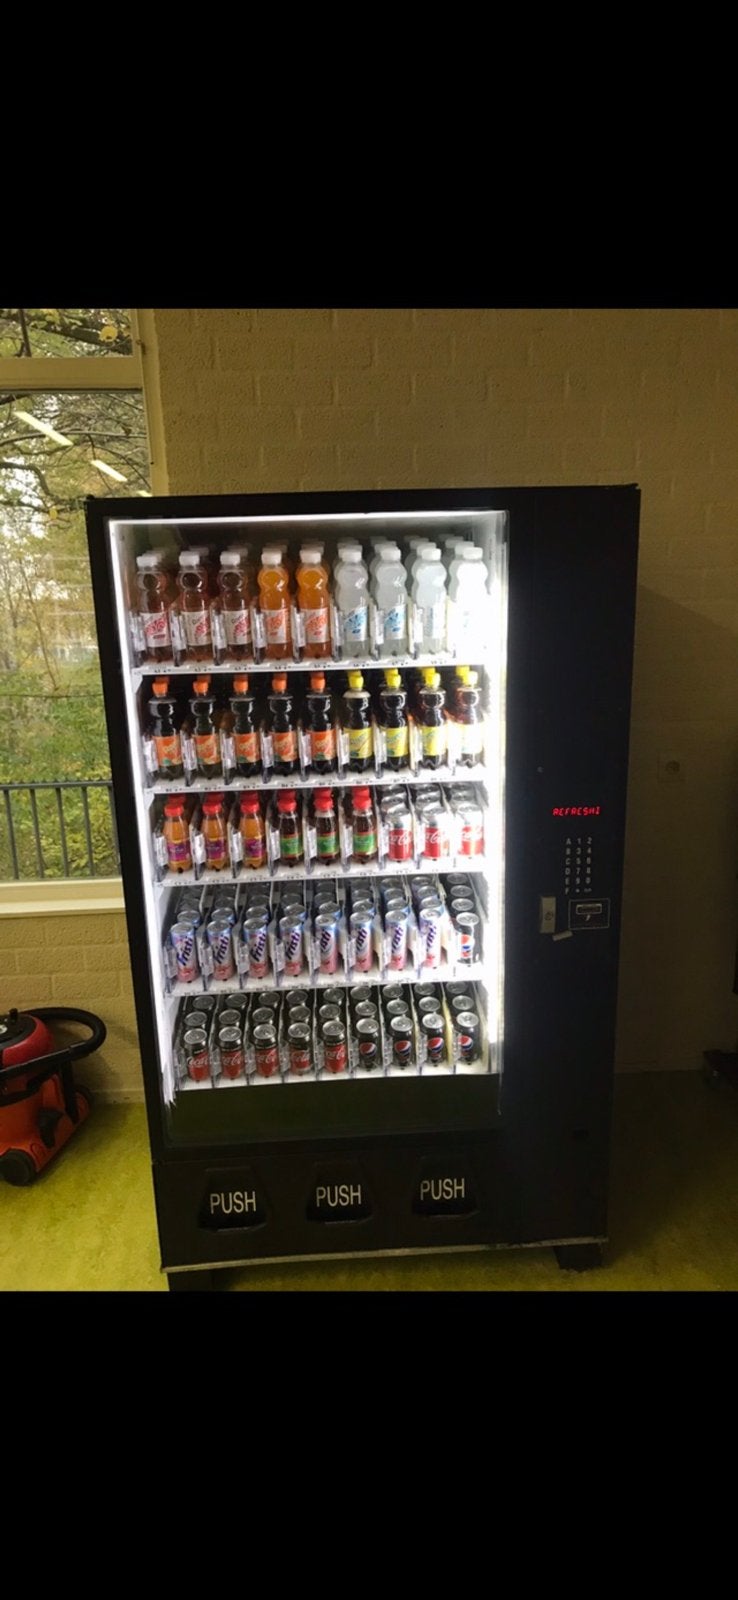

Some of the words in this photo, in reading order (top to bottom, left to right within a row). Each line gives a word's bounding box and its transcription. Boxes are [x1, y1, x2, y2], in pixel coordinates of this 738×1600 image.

[316, 1184, 362, 1207] PUSH
[420, 1178, 465, 1201] PUSH
[210, 1191, 257, 1214] PUSH
